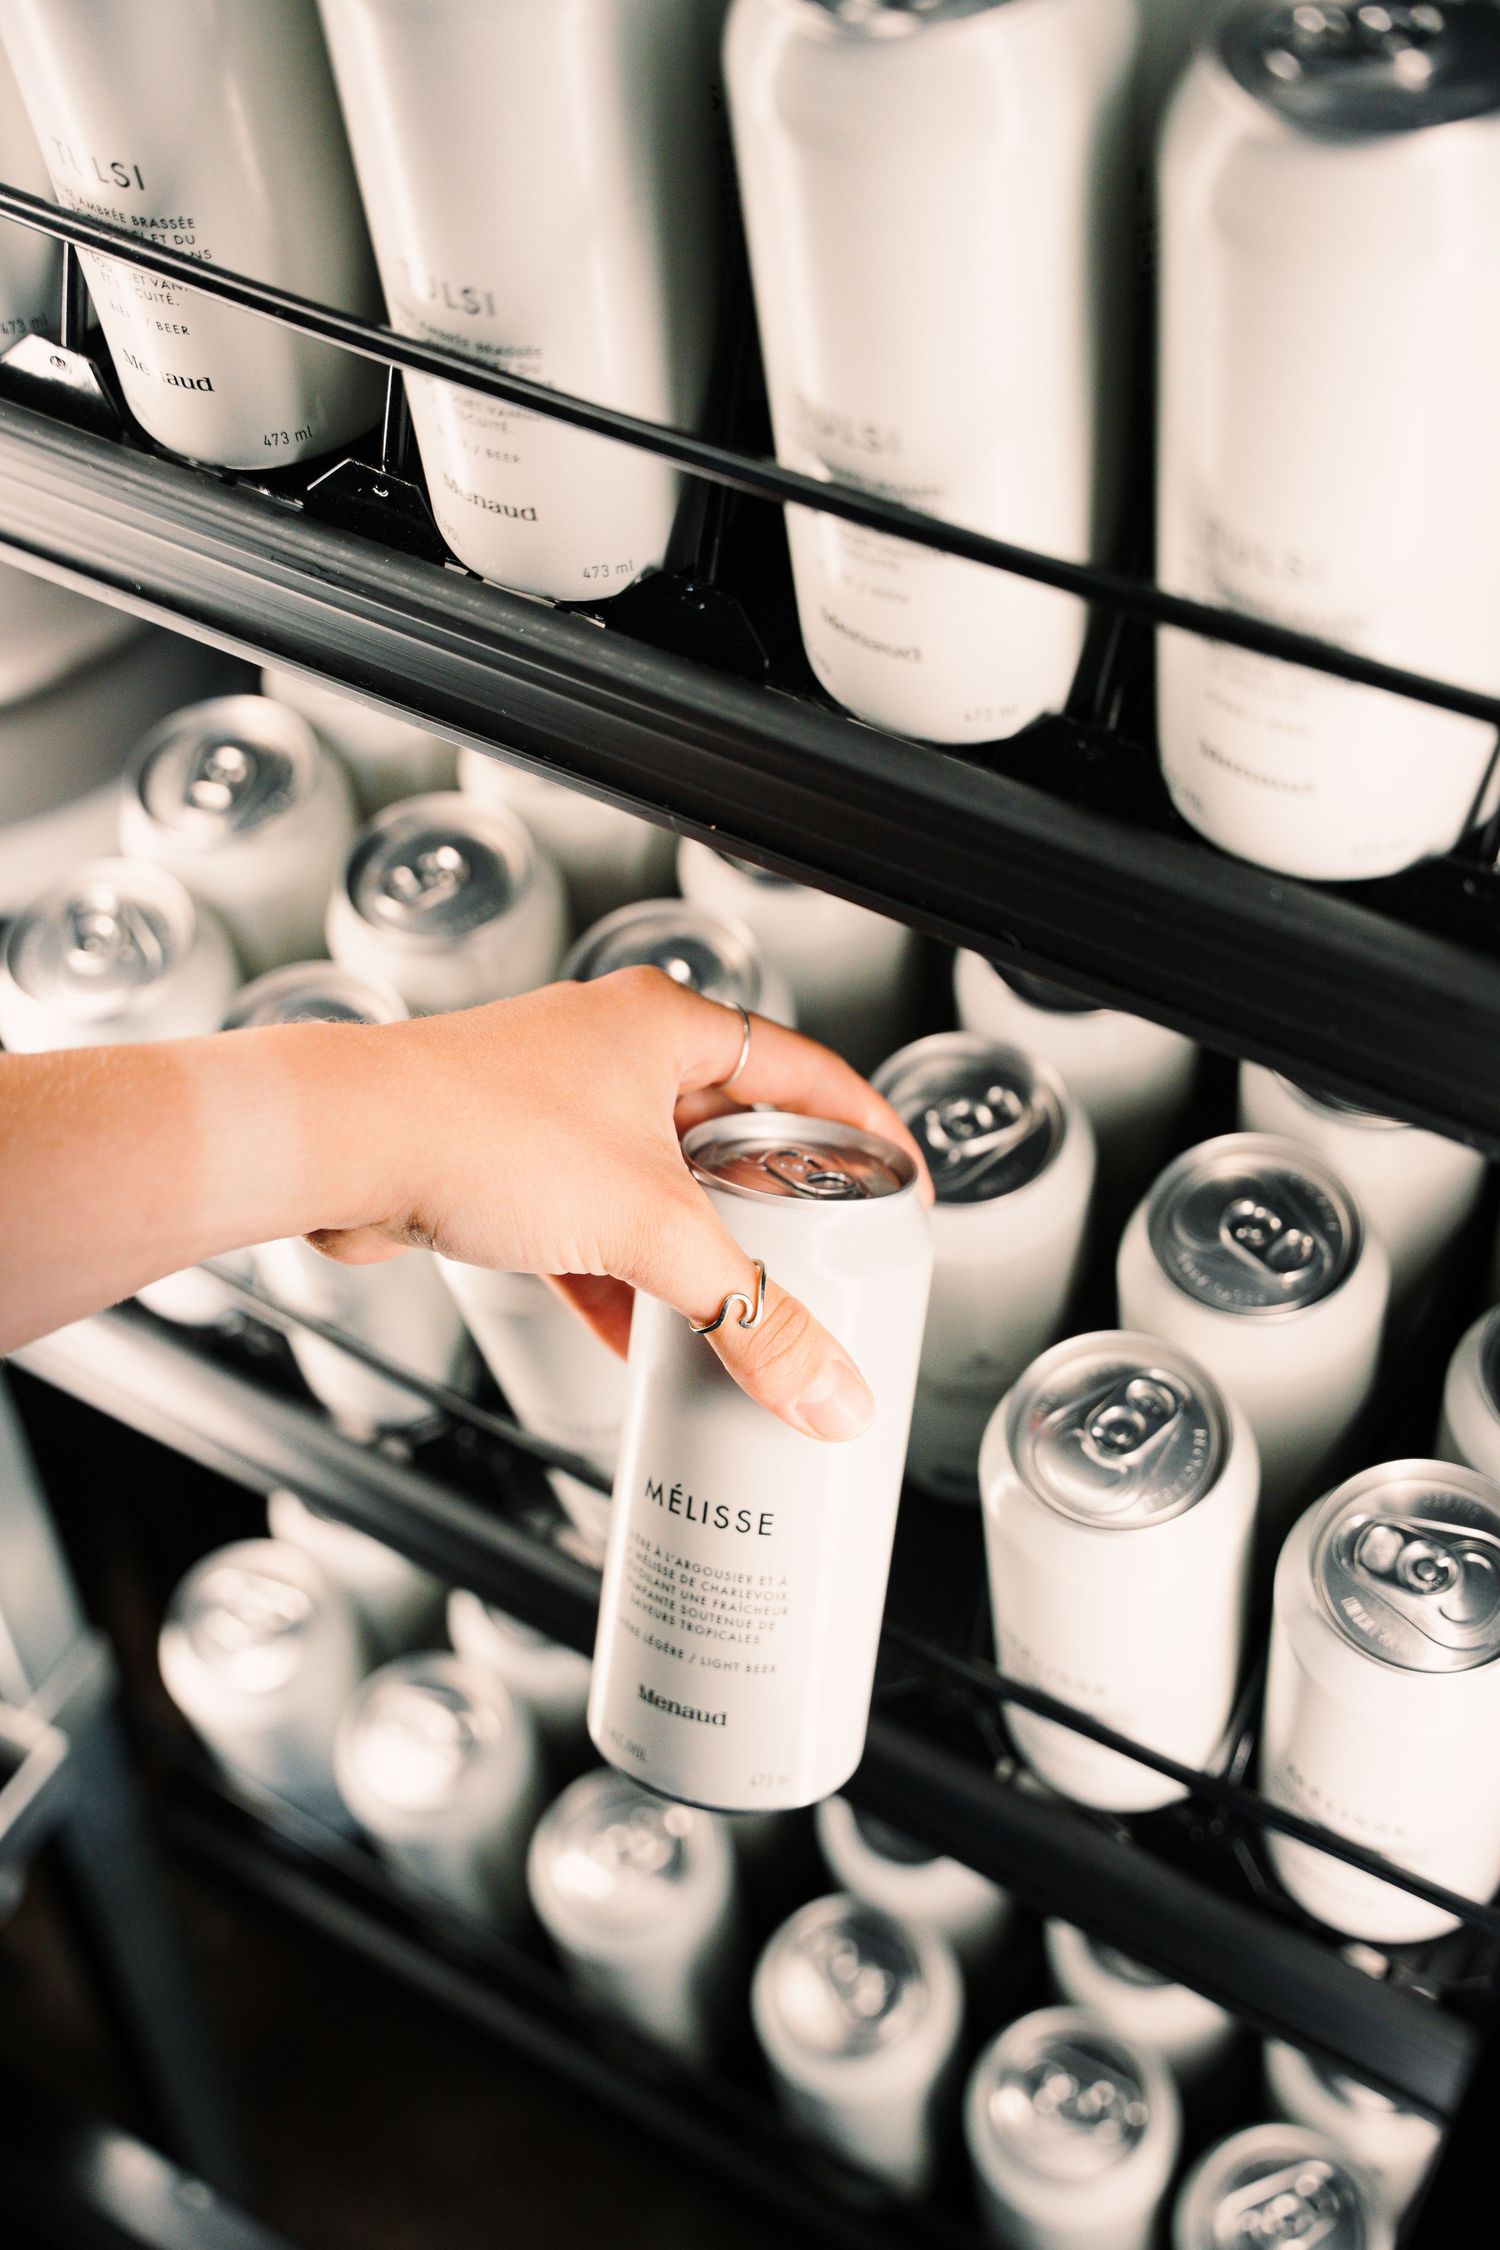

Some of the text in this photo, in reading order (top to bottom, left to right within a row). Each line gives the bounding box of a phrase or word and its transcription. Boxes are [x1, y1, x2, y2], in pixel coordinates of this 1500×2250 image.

[131, 214, 197, 231] BRASSÉE
[173, 233, 196, 246] DU
[155, 320, 192, 337] BEER
[262, 425, 314, 447] 473 ml
[581, 558, 635, 580] 473 ml
[643, 1474, 776, 1537] MÉLISSE
[680, 1573, 697, 1589] DE
[680, 1588, 707, 1607] UNE
[681, 1604, 753, 1630] SOUTENUE
[758, 1619, 777, 1632] DE
[700, 1655, 741, 1672] LIGHT
[636, 1681, 729, 1727] Menaud
